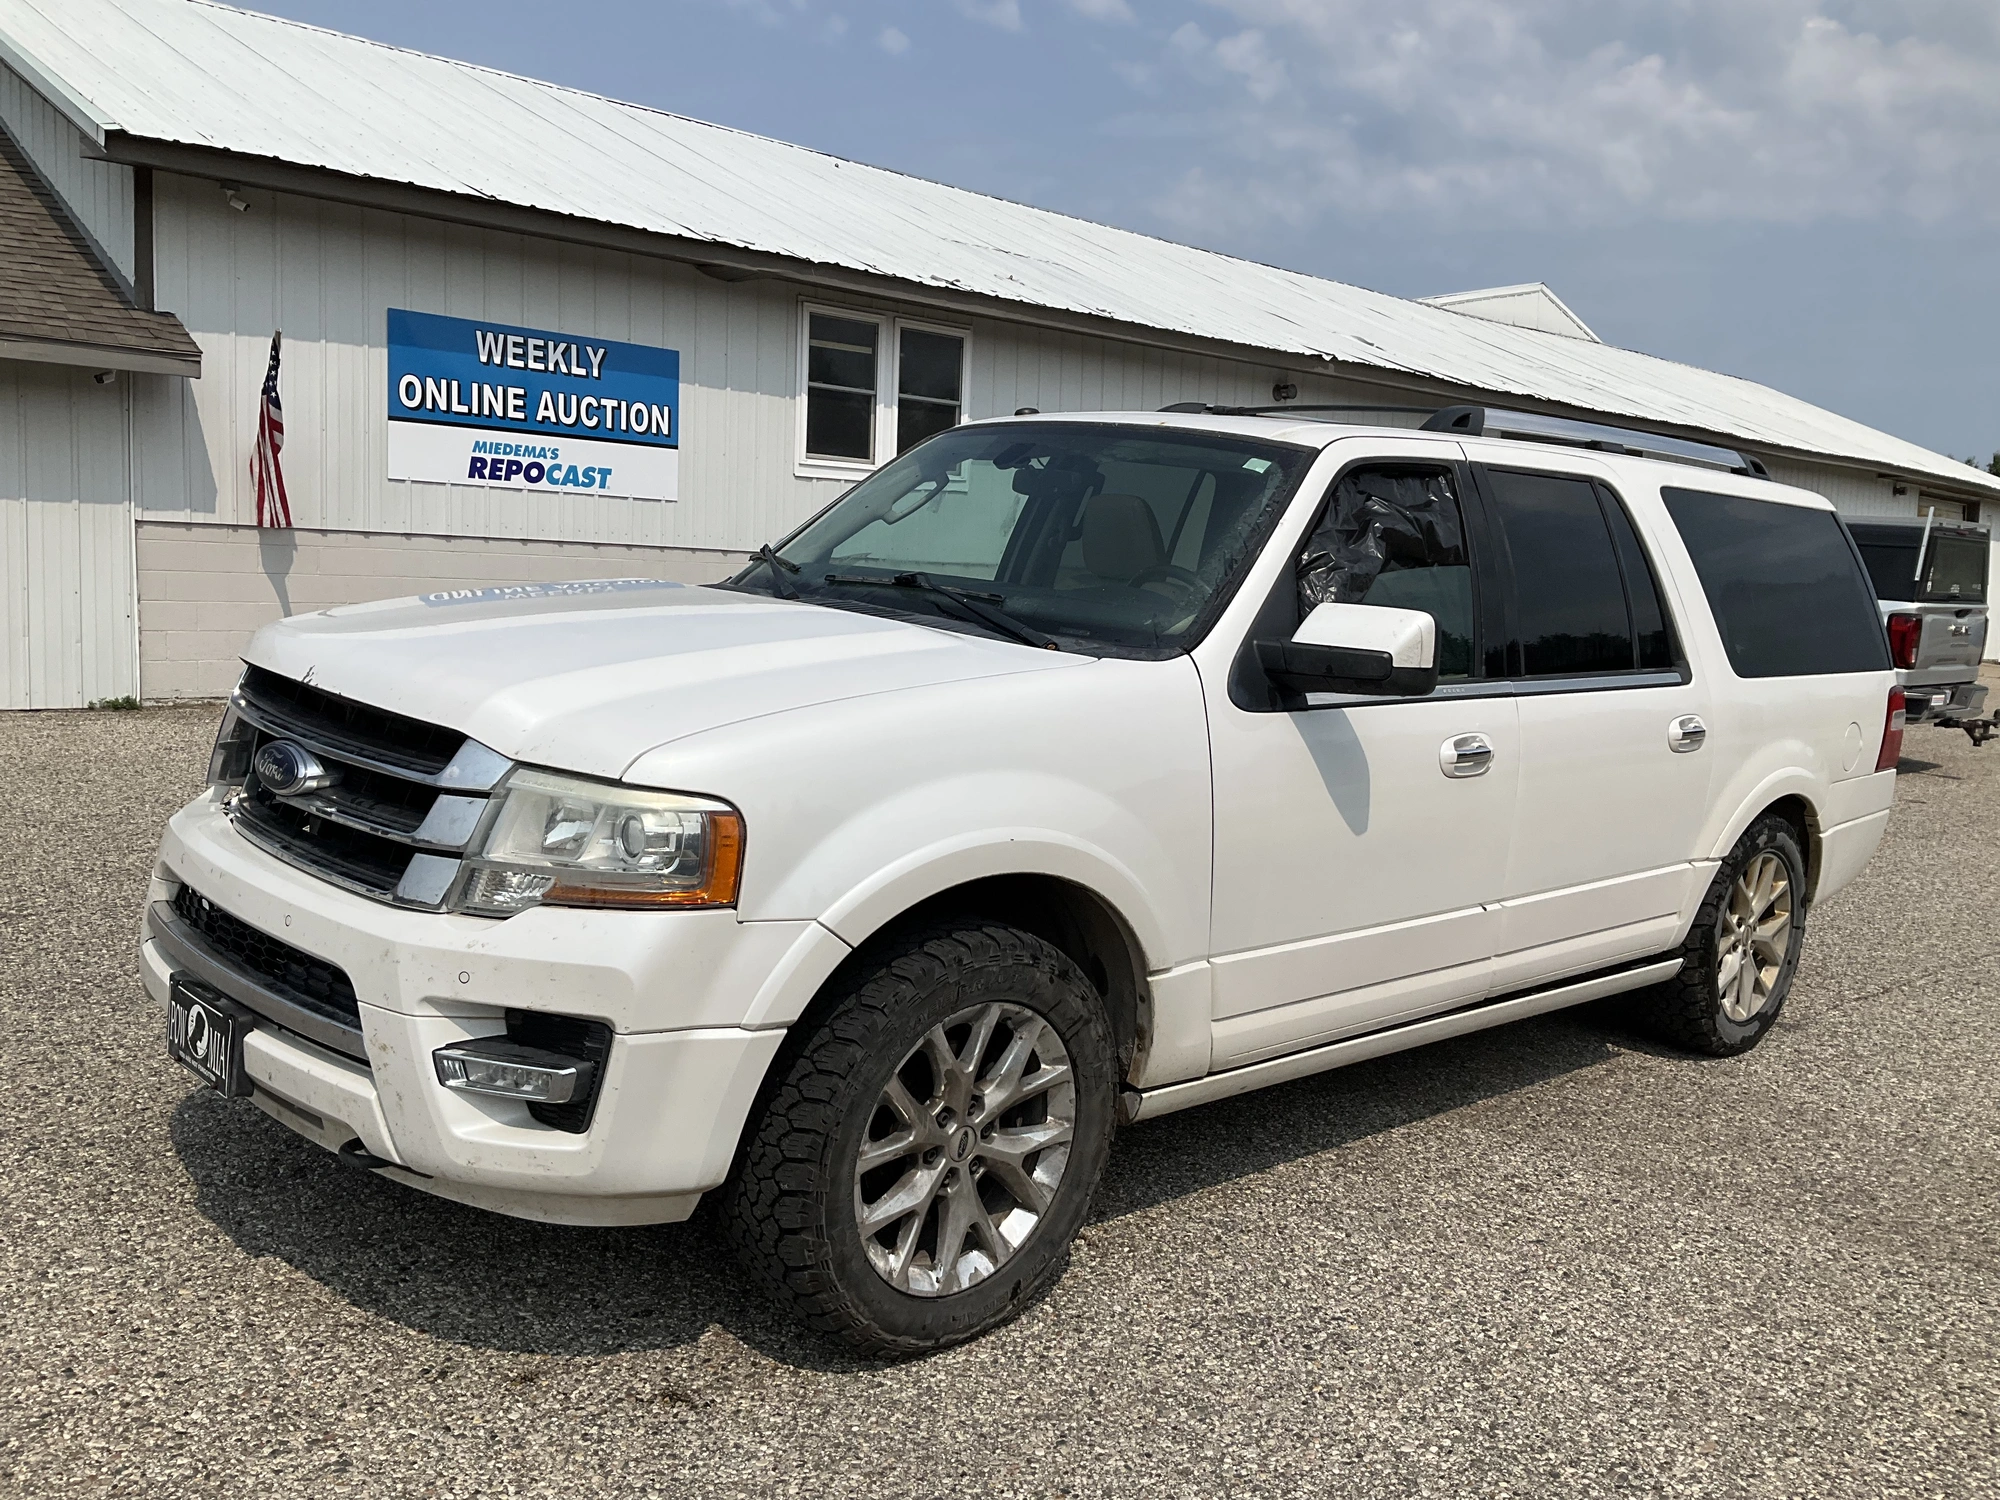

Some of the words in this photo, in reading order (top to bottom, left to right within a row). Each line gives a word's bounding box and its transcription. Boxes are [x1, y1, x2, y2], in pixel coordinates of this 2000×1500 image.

[475, 330, 607, 380] WEEKLY
[398, 373, 527, 420] ONLINE
[535, 390, 670, 436] AUCTION
[471, 440, 560, 460] MIEDEMA'S
[467, 456, 613, 490] REPOCAST
[259, 748, 289, 782] Ford
[169, 1000, 188, 1050] POW
[207, 1026, 226, 1080] MIA
